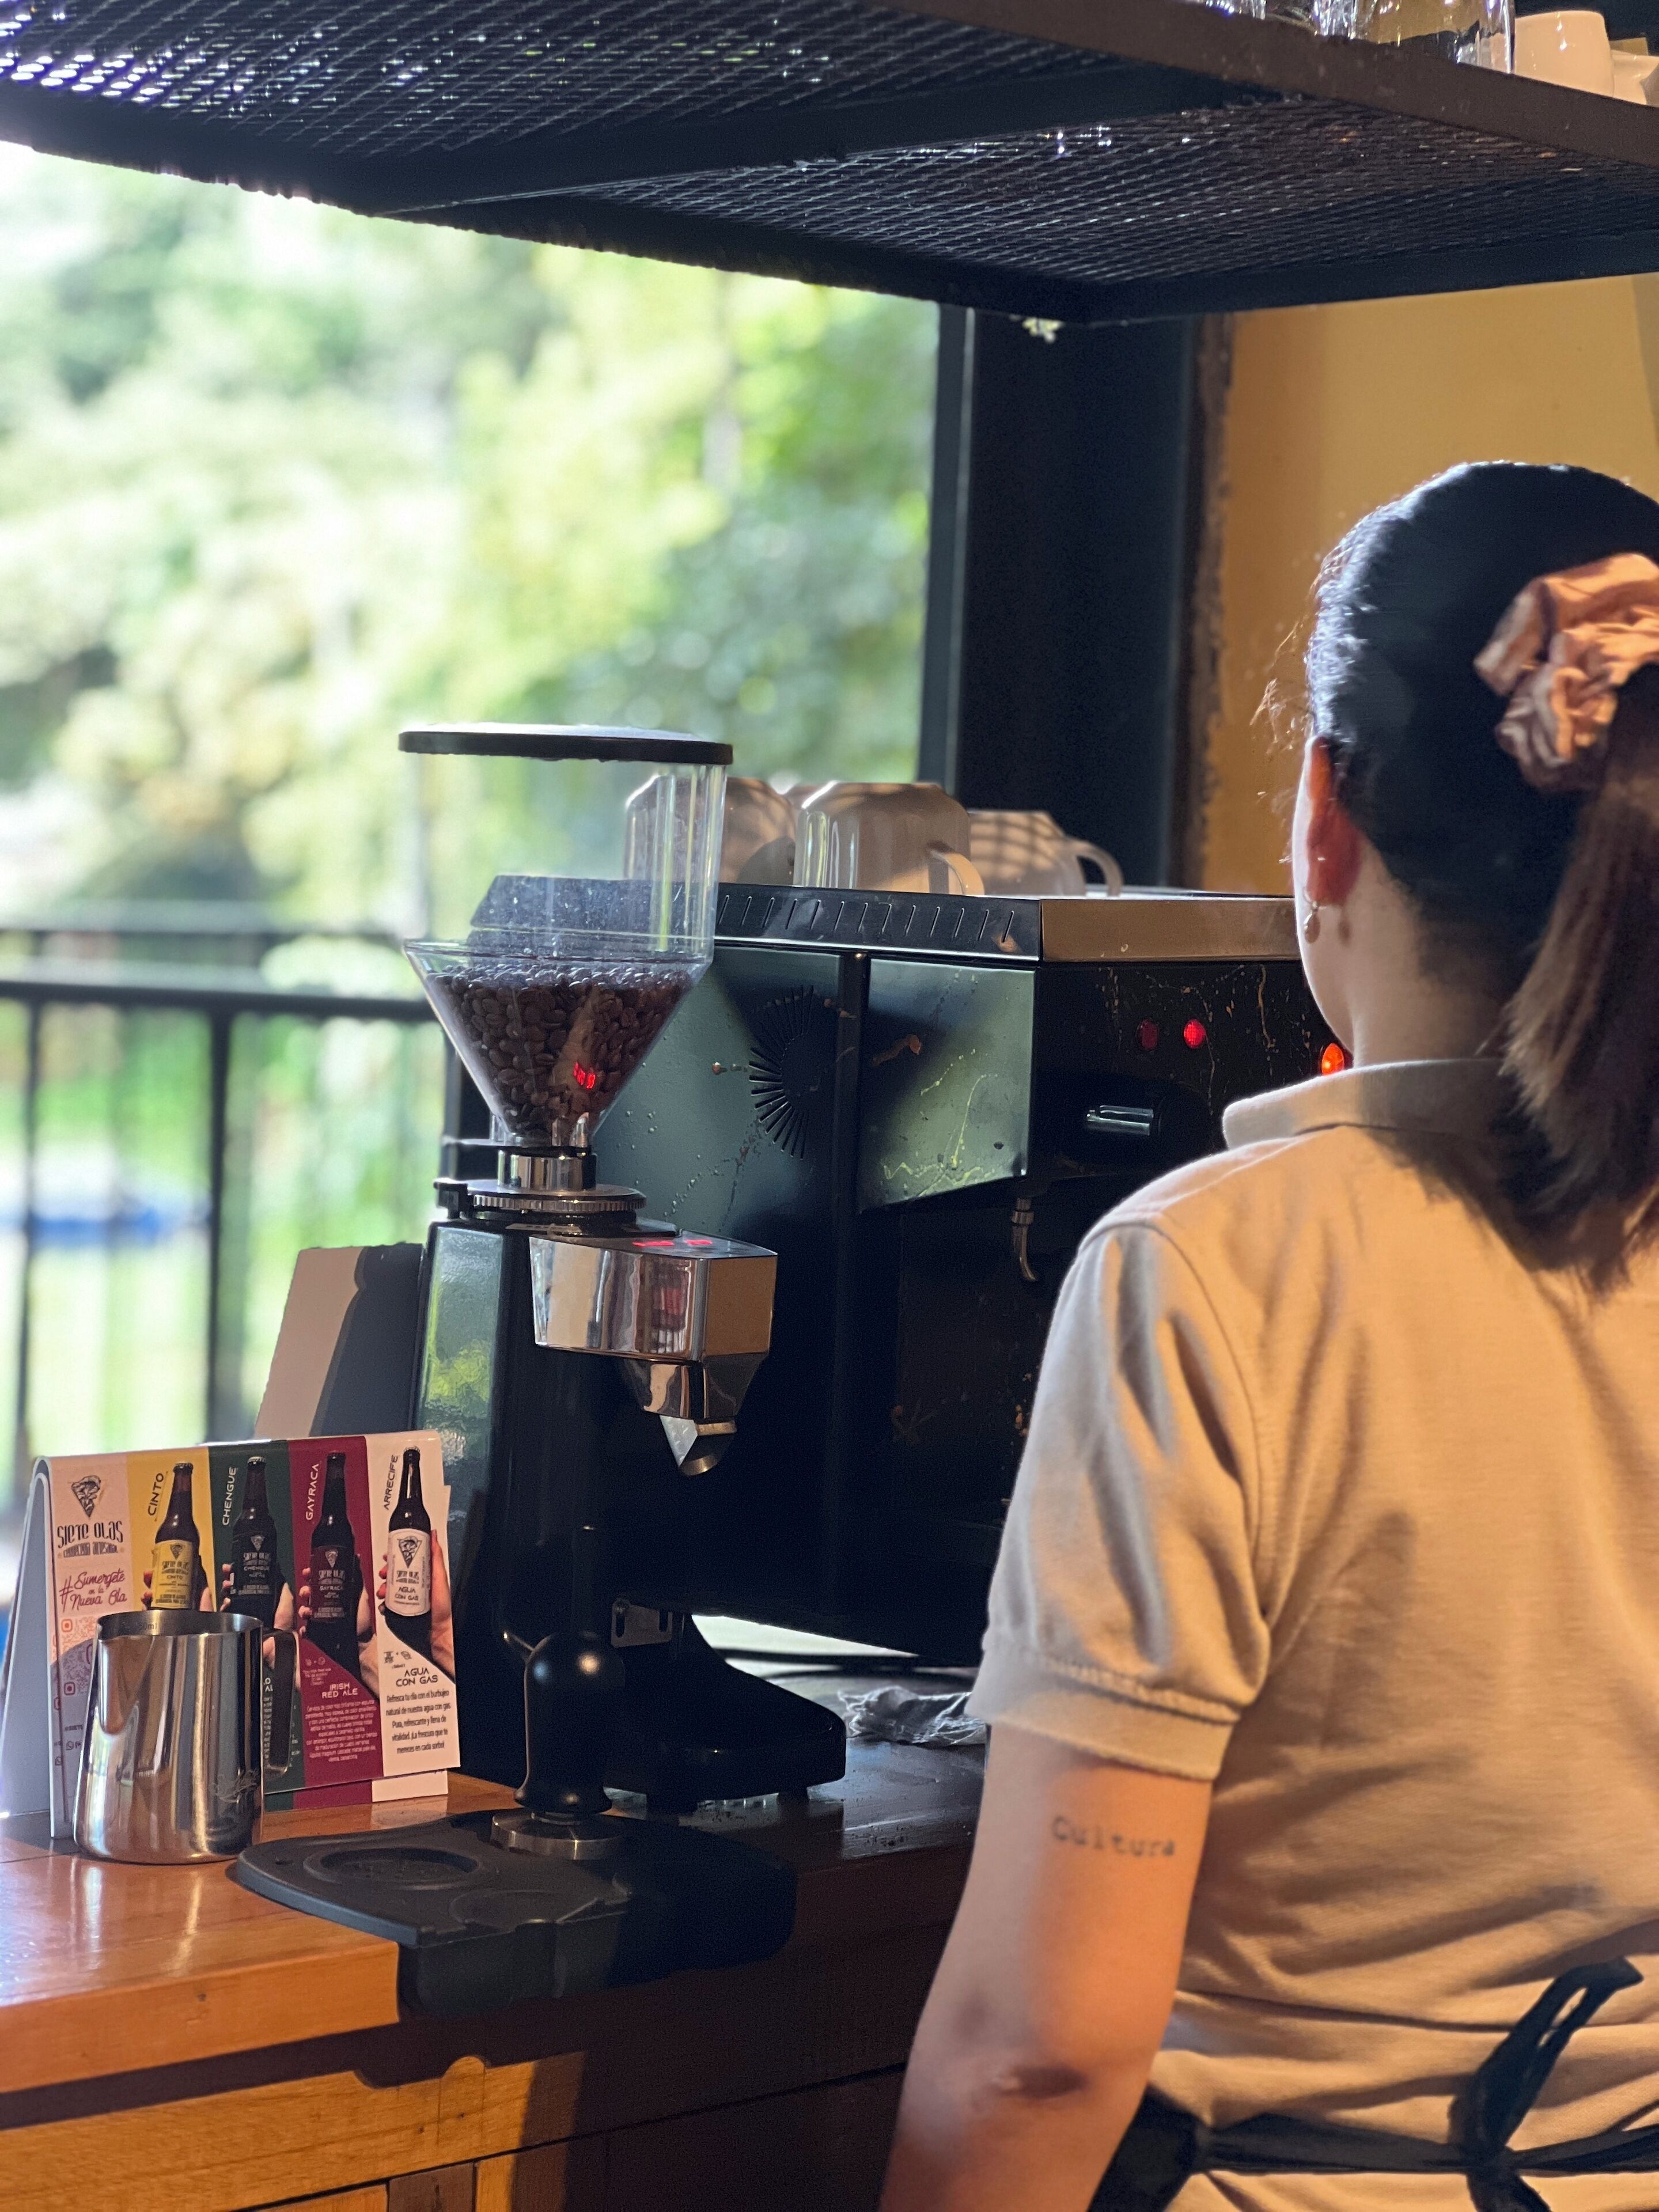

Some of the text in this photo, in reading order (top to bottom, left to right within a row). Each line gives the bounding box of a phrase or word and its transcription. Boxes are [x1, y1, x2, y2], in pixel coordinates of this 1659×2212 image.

[306, 1464, 319, 1520] GAYRACA
[384, 1455, 398, 1510] ARRECIFE
[148, 1473, 164, 1516] CINTO
[222, 1467, 237, 1525] CHENGUE
[70, 1588, 127, 1611] Nueva Ola
[396, 1675, 438, 1687] CON GAS
[404, 1667, 429, 1677] AGUA
[322, 1688, 358, 1699] RED ALE
[329, 1683, 350, 1691] IRISH
